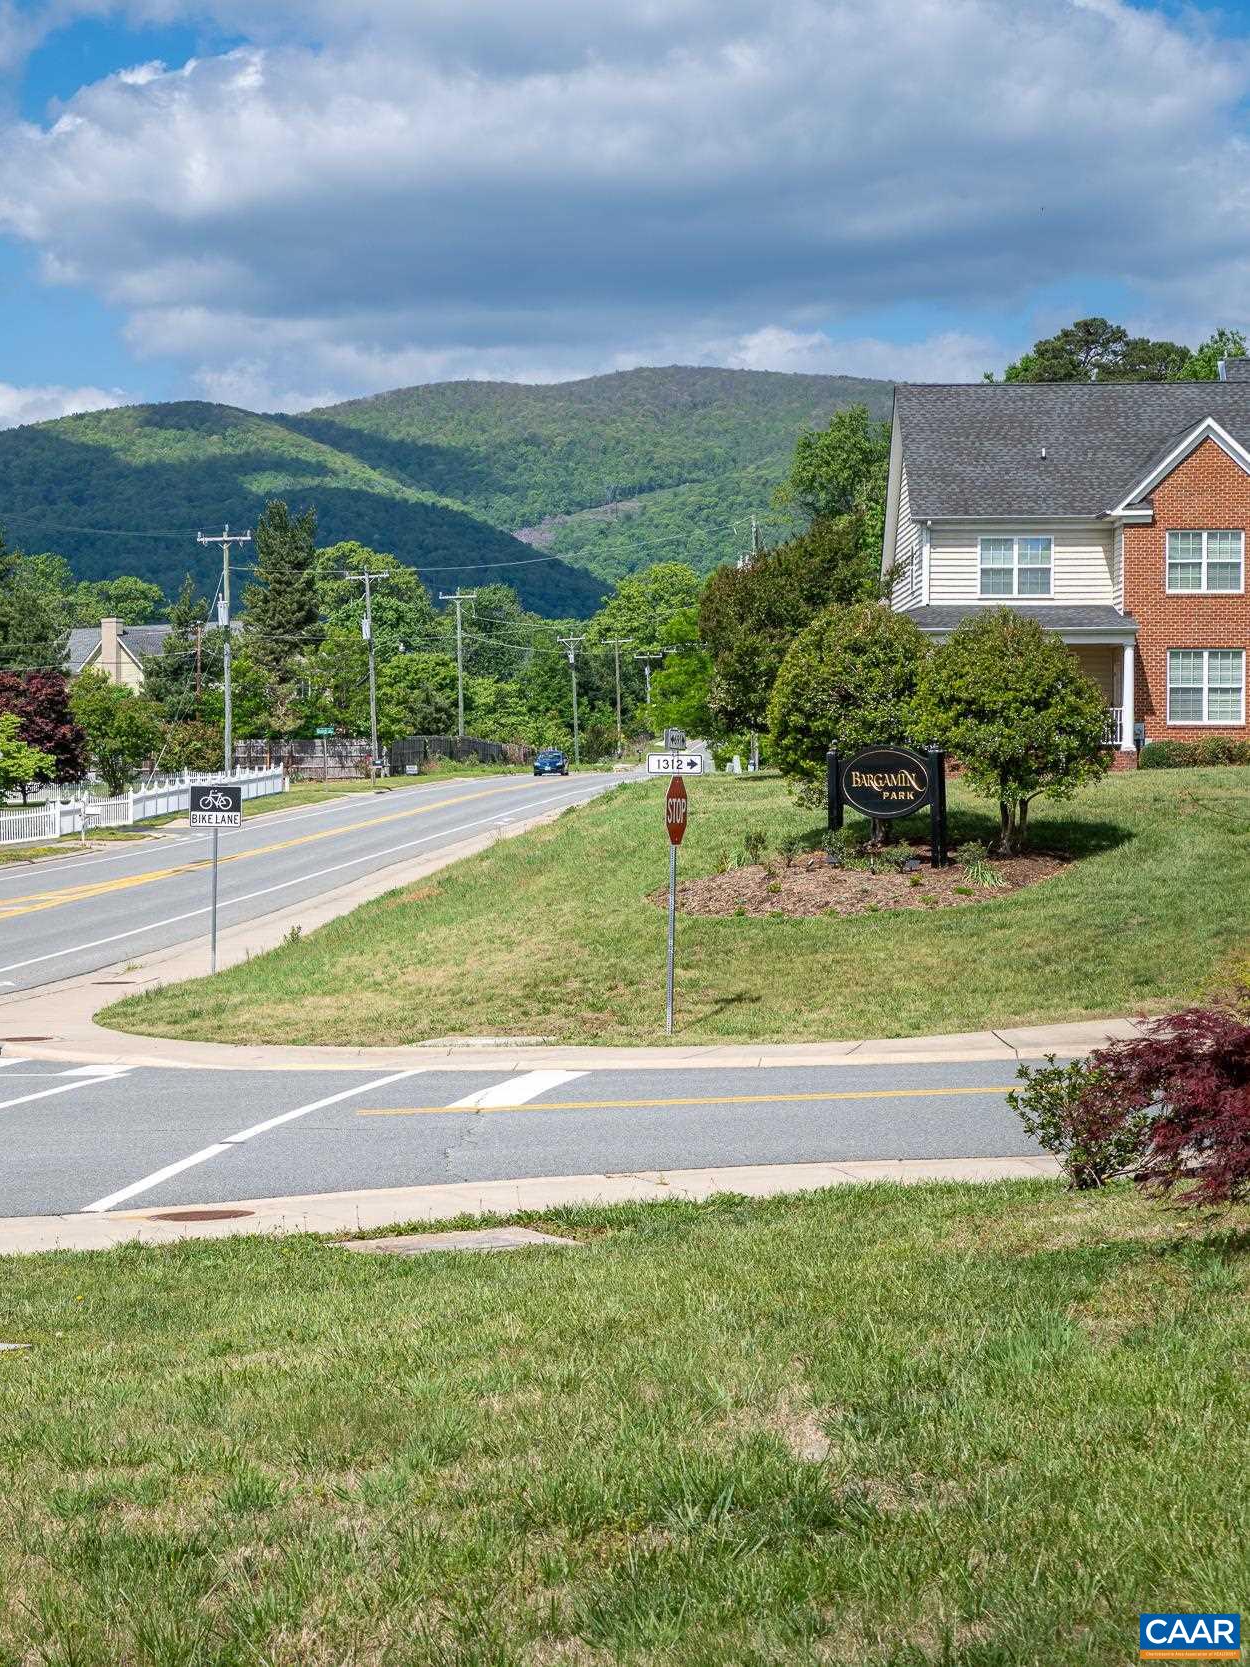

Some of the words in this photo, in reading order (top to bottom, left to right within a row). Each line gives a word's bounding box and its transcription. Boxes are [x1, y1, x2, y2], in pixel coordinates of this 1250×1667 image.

[657, 759, 683, 770] 1312
[883, 791, 915, 800] PARK
[667, 798, 686, 824] STOP
[191, 814, 213, 824] BIKE
[215, 814, 239, 825] LANE
